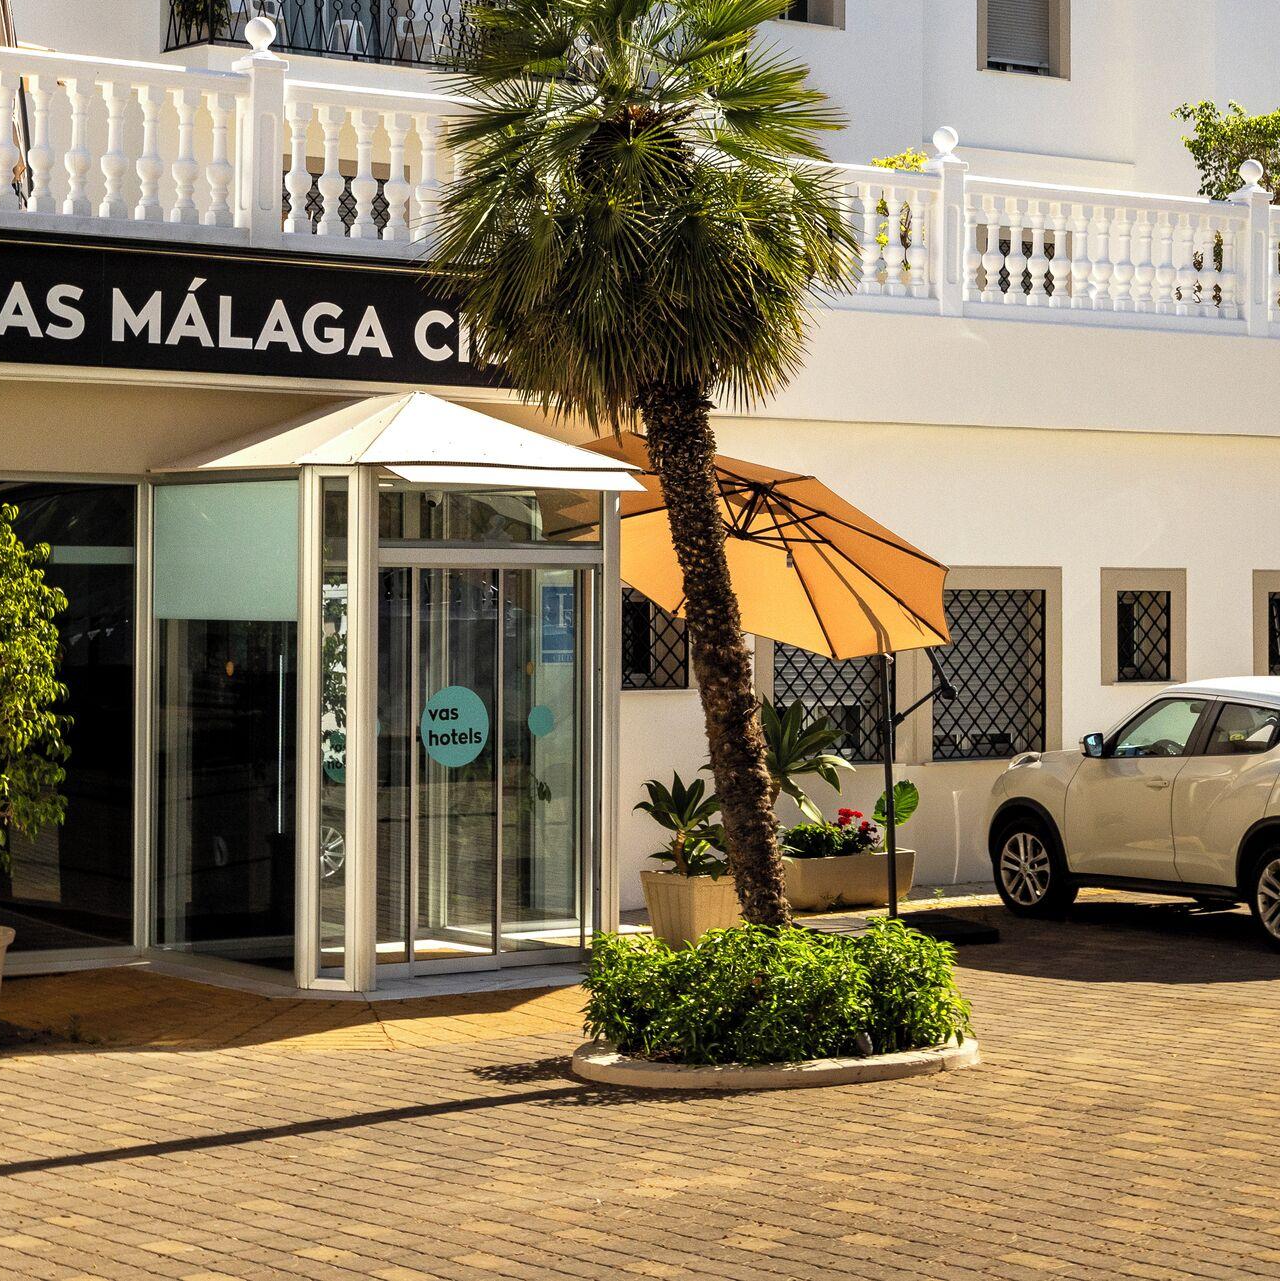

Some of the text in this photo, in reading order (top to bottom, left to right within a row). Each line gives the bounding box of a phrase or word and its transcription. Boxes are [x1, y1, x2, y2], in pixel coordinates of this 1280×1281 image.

[111, 277, 393, 358] MÁLAGA
[428, 707, 459, 722] vas
[428, 727, 483, 747] hotels
